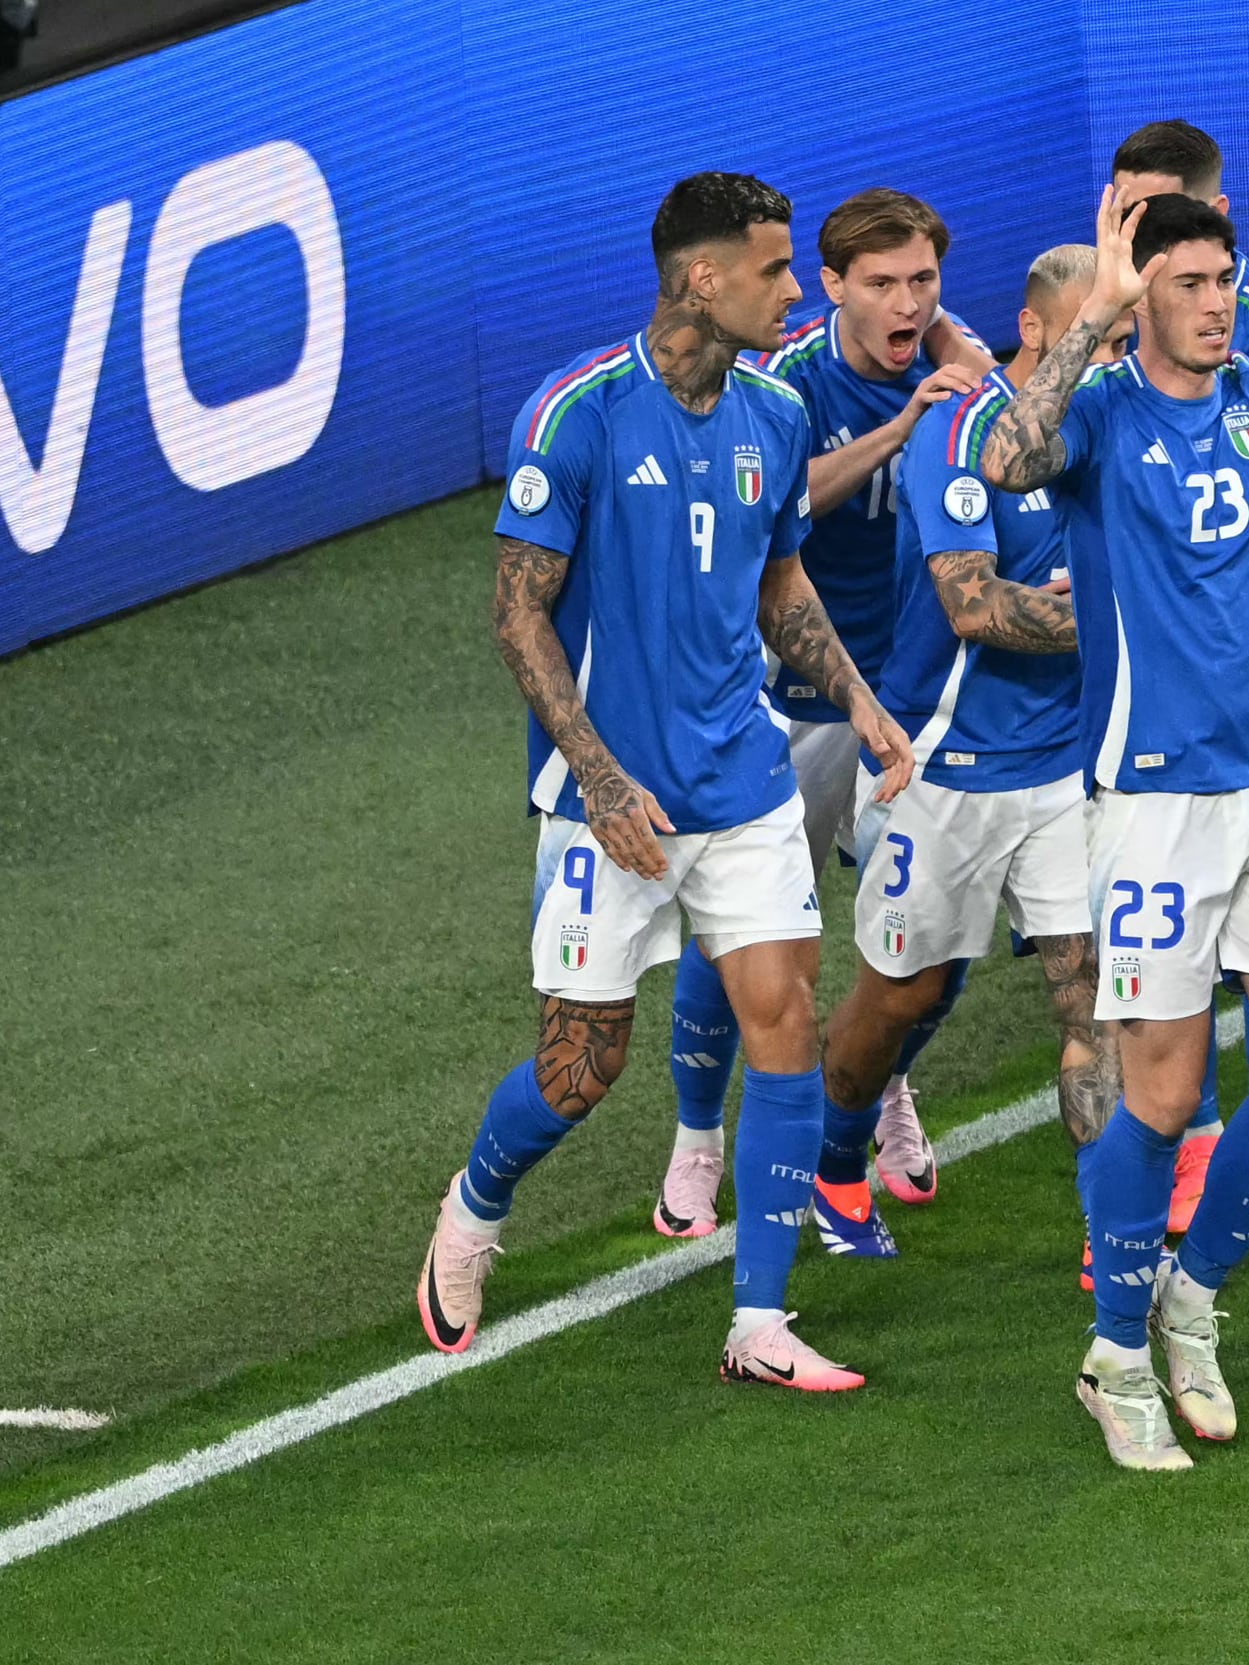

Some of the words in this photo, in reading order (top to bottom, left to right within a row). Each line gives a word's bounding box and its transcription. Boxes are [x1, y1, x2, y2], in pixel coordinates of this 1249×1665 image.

[0, 139, 346, 555] VO
[736, 457, 760, 469] ITALIA
[689, 502, 716, 573] 9
[1185, 468, 1249, 543] 23
[563, 846, 595, 915] 9
[884, 832, 914, 898] 3
[562, 933, 585, 942] ITALIA
[1109, 879, 1185, 950] 23
[1115, 966, 1137, 974] ITALIA
[671, 1009, 728, 1036] TALIA
